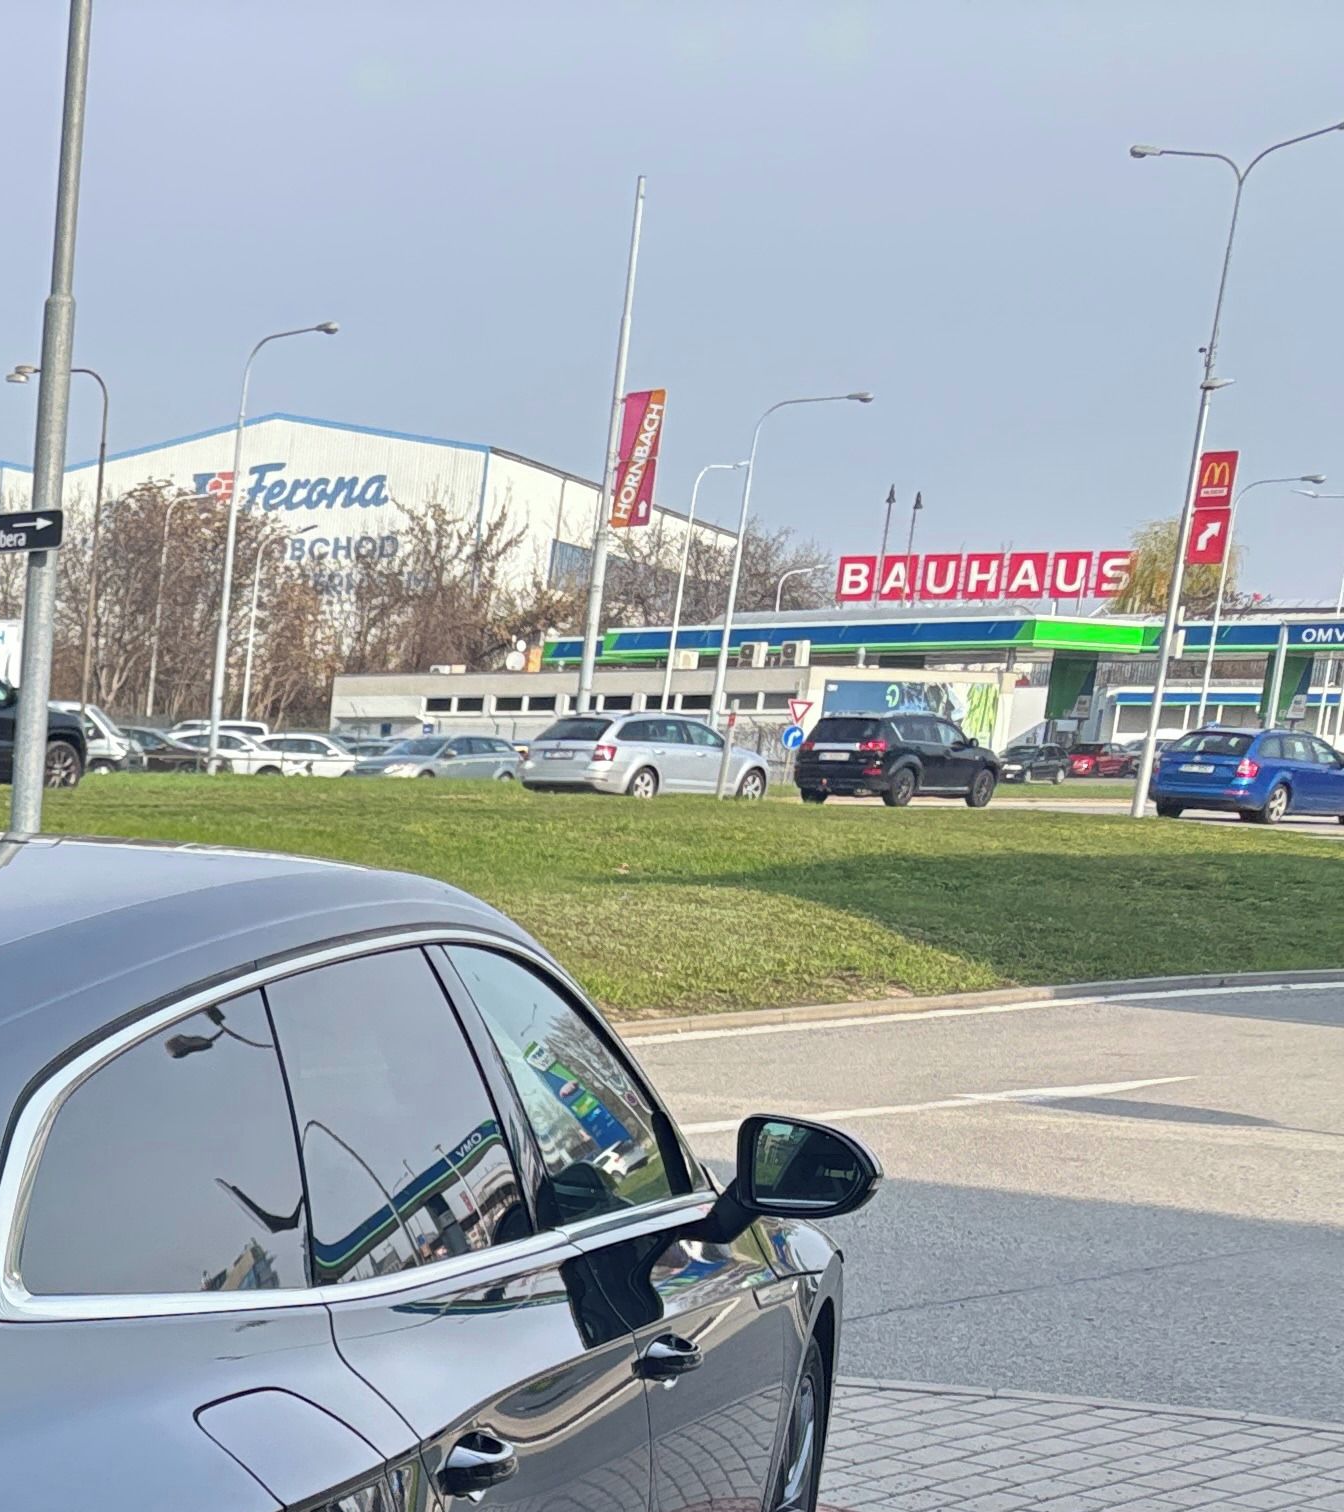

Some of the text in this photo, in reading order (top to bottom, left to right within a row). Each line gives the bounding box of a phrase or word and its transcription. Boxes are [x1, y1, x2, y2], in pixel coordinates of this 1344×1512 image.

[614, 403, 664, 518] HORNBACH
[245, 462, 389, 512] Ferona
[841, 557, 1130, 595] BAUHAUS
